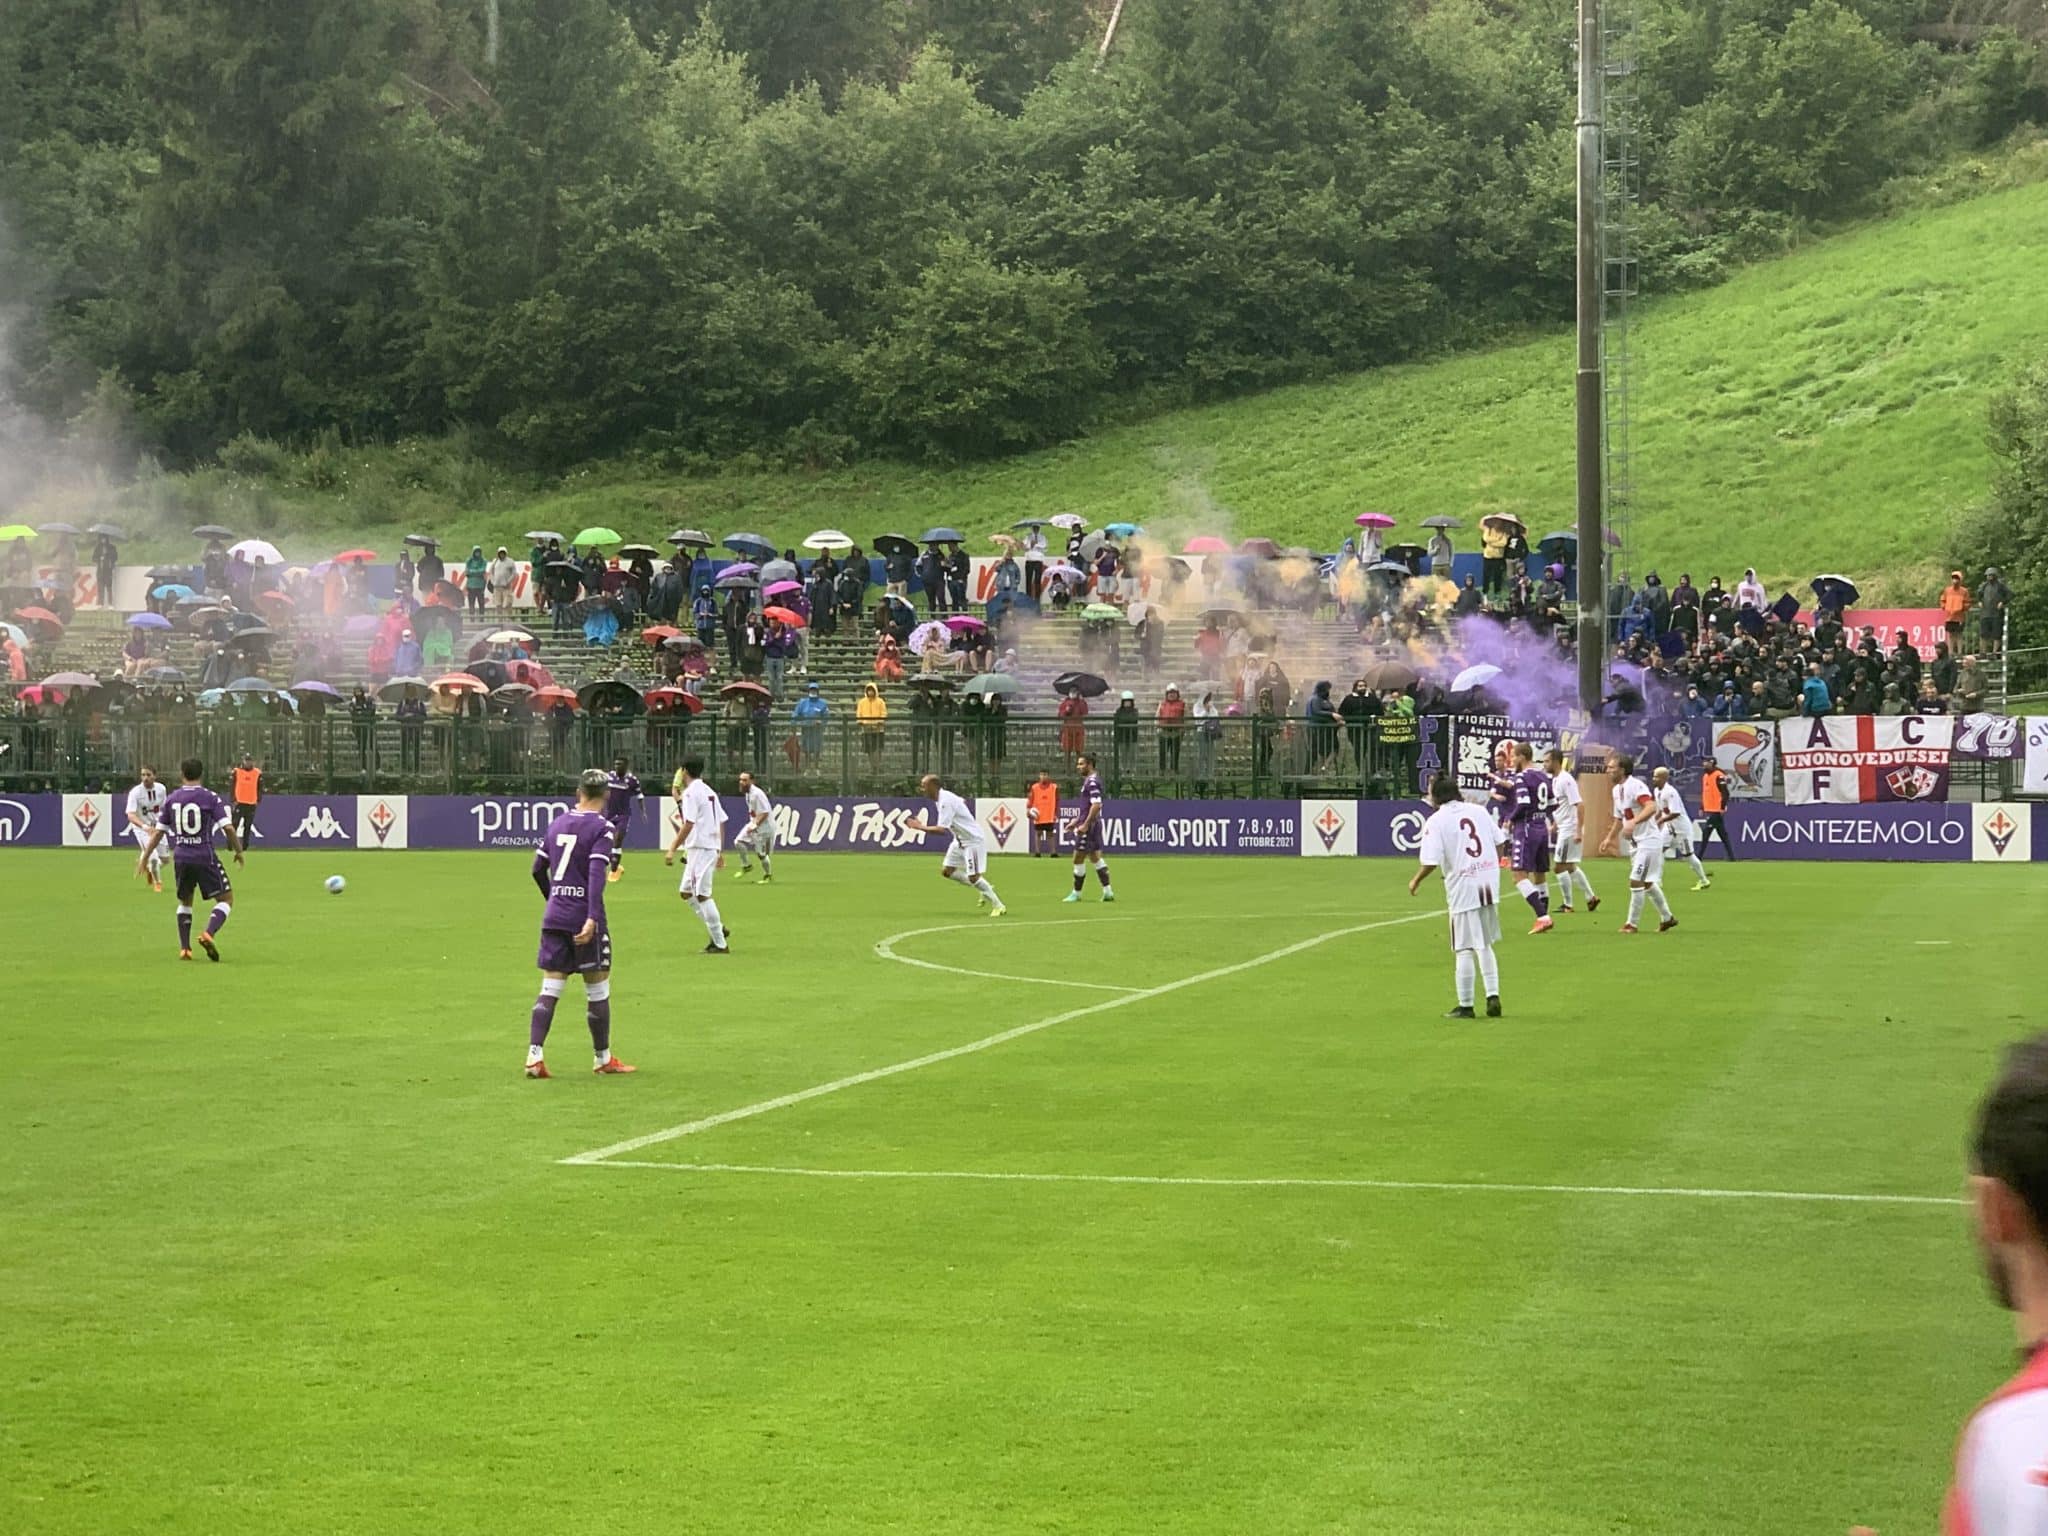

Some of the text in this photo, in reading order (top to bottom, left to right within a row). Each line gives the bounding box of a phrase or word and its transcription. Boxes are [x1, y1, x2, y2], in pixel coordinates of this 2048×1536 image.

[1458, 715, 1534, 729] FIORENTINA
[1807, 716, 1926, 748] A C
[1785, 750, 1949, 769] UNONOVEDUESEI
[1537, 782, 1549, 810] 9
[1812, 770, 1831, 800] F
[172, 803, 202, 835] 10
[470, 801, 569, 842] prim
[849, 803, 929, 847] FASSA
[1138, 823, 1165, 842] dello
[1167, 818, 1230, 847] SPORT
[1741, 819, 1965, 844] MONTEZEMOLO
[491, 837, 529, 845] AGENZIA
[1238, 836, 1294, 847] OTTOBRE 2021
[1460, 817, 1482, 858] 3
[553, 833, 578, 881] 7
[551, 885, 585, 898] prima
